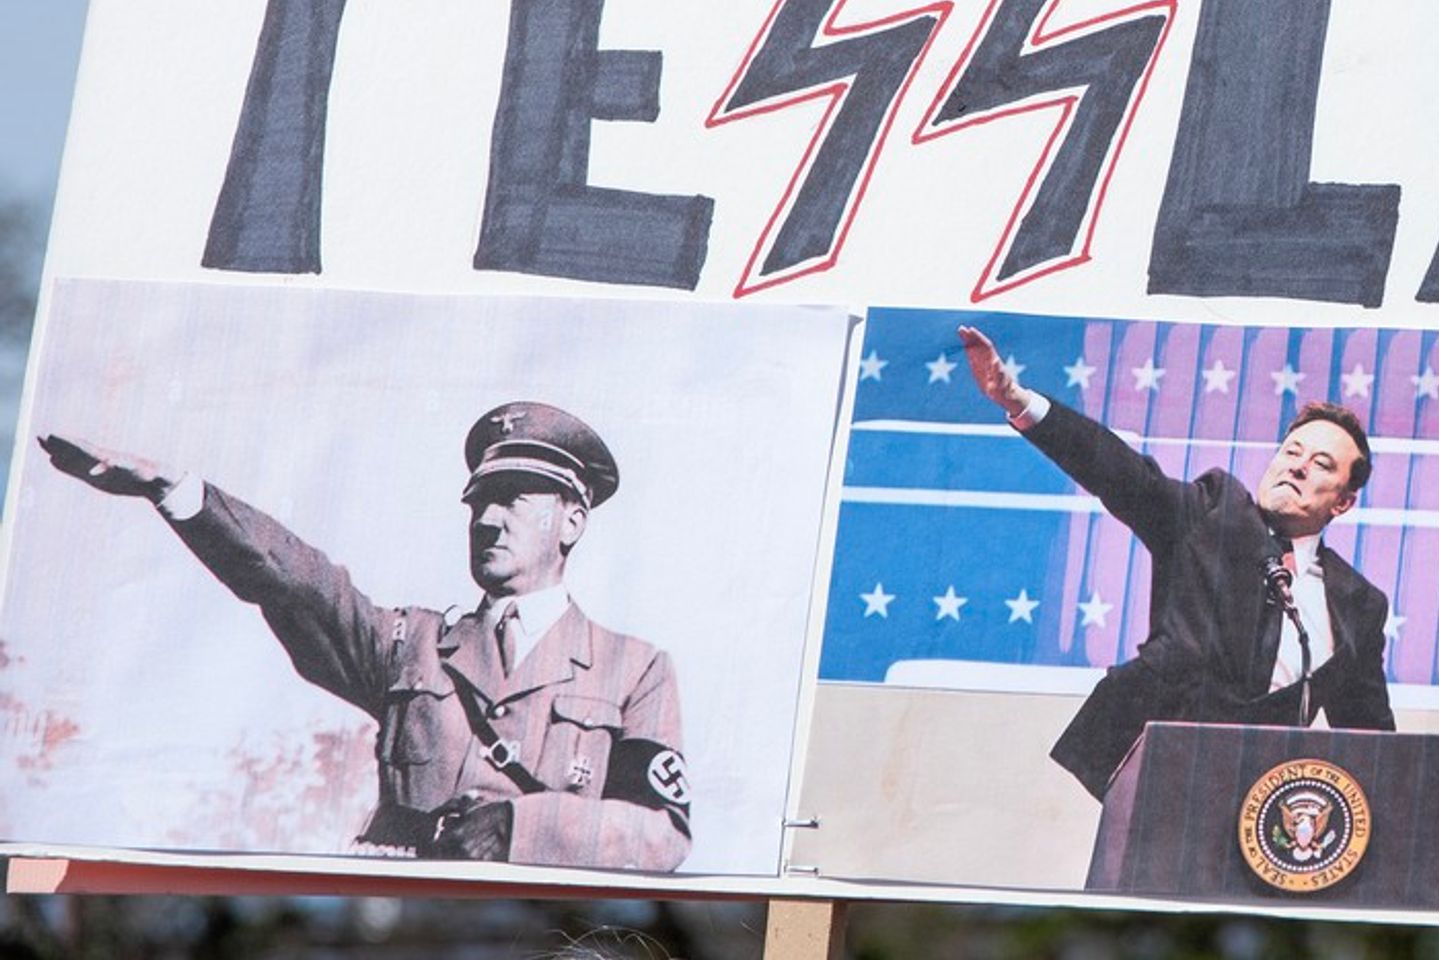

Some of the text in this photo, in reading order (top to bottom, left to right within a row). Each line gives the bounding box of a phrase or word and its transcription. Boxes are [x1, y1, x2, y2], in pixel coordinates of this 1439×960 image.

[1244, 763, 1306, 821] PRESIDENT
[1343, 783, 1366, 838] UNITED
[1256, 856, 1287, 885] SEAL
[1311, 850, 1358, 887] STATES
